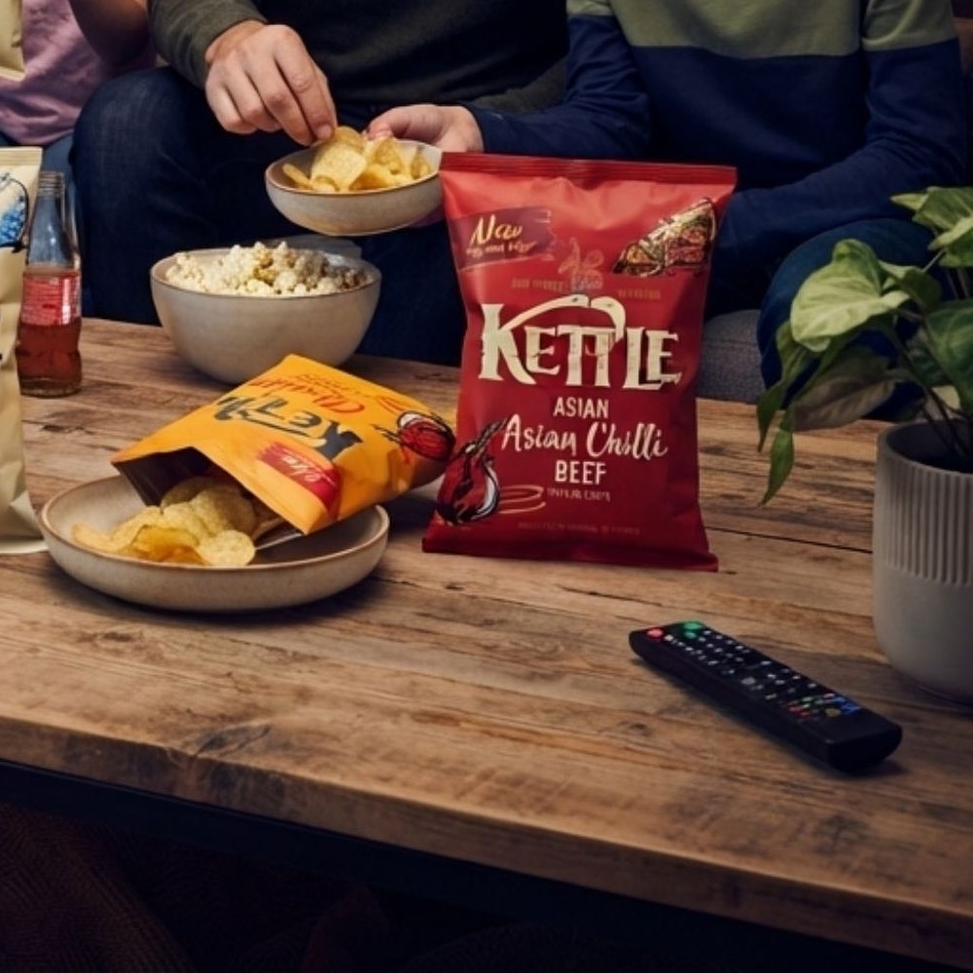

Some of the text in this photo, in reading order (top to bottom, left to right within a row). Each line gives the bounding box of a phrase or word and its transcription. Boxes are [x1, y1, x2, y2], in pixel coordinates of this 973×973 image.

[478, 294, 682, 391] KETTLE
[553, 396, 609, 419] ASIAN
[501, 414, 577, 457] Asian
[555, 459, 607, 485] BEEF
